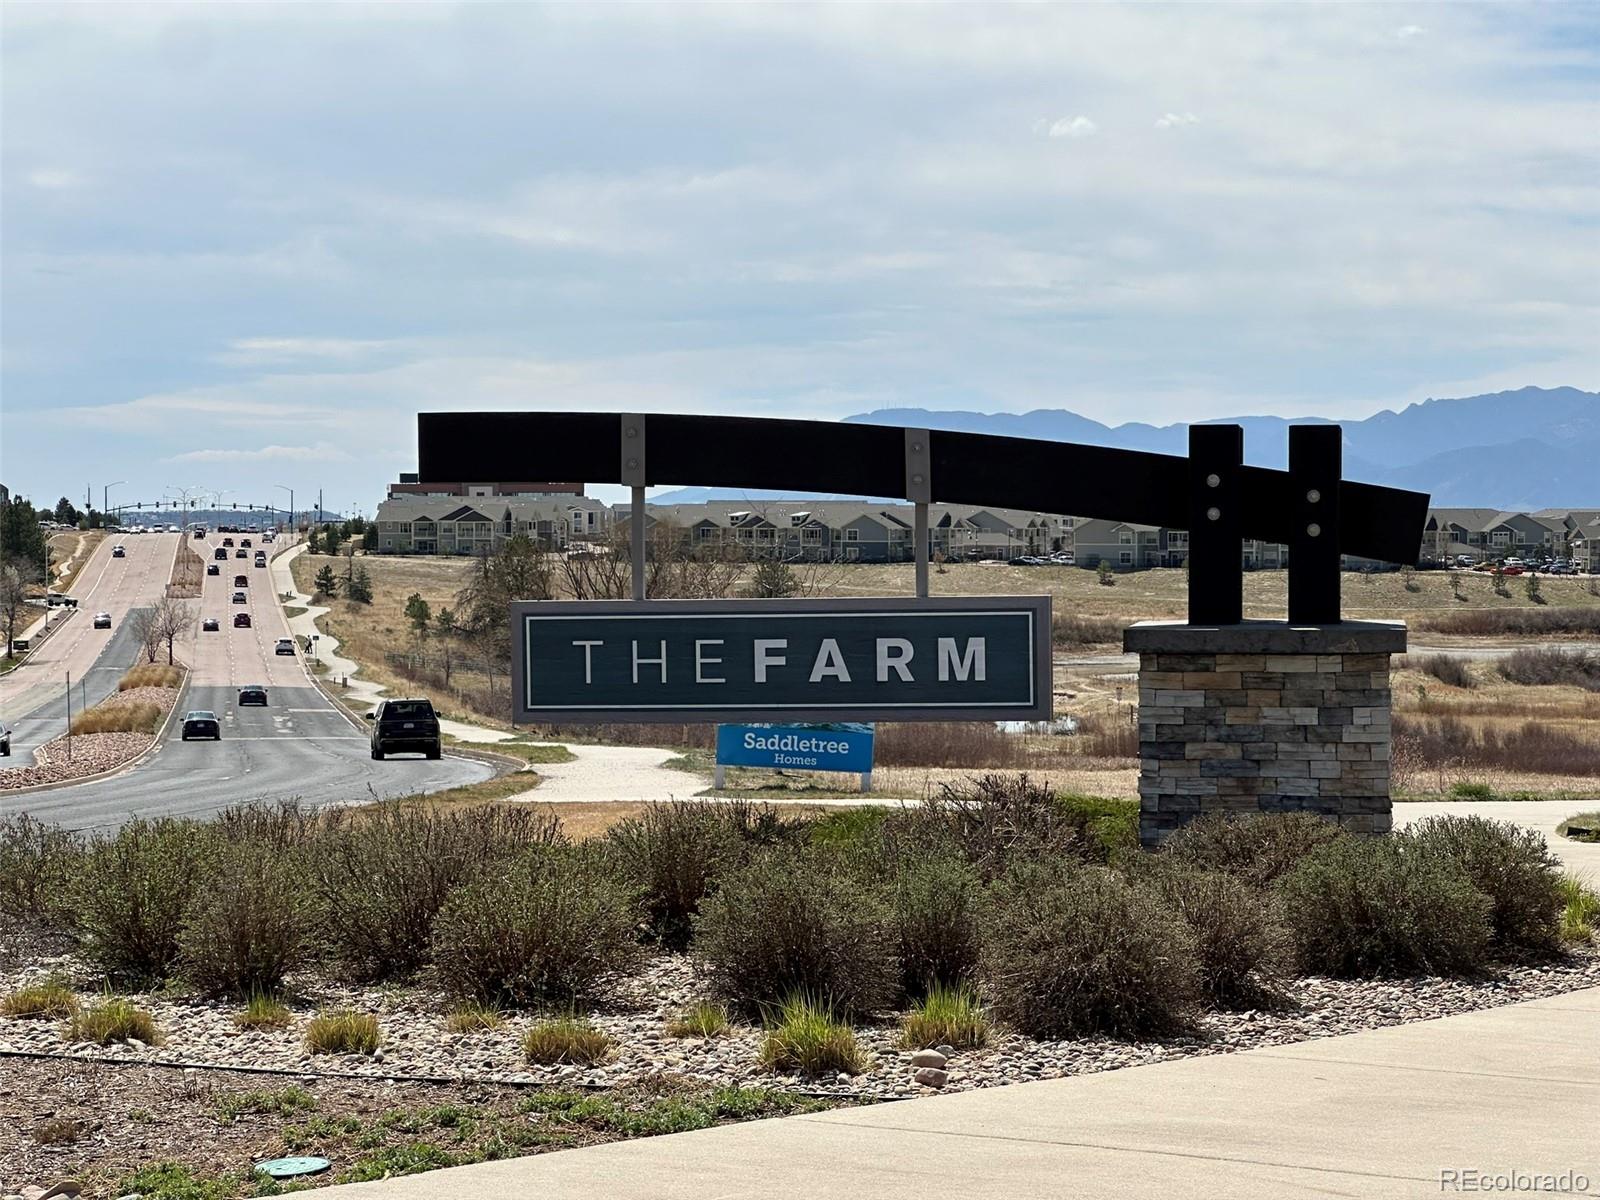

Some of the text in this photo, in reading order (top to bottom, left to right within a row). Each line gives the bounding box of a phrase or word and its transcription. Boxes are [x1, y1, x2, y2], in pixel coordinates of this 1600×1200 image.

[753, 636, 986, 683] FARM
[743, 732, 849, 754] Saddletree
[774, 753, 817, 766] Homes
